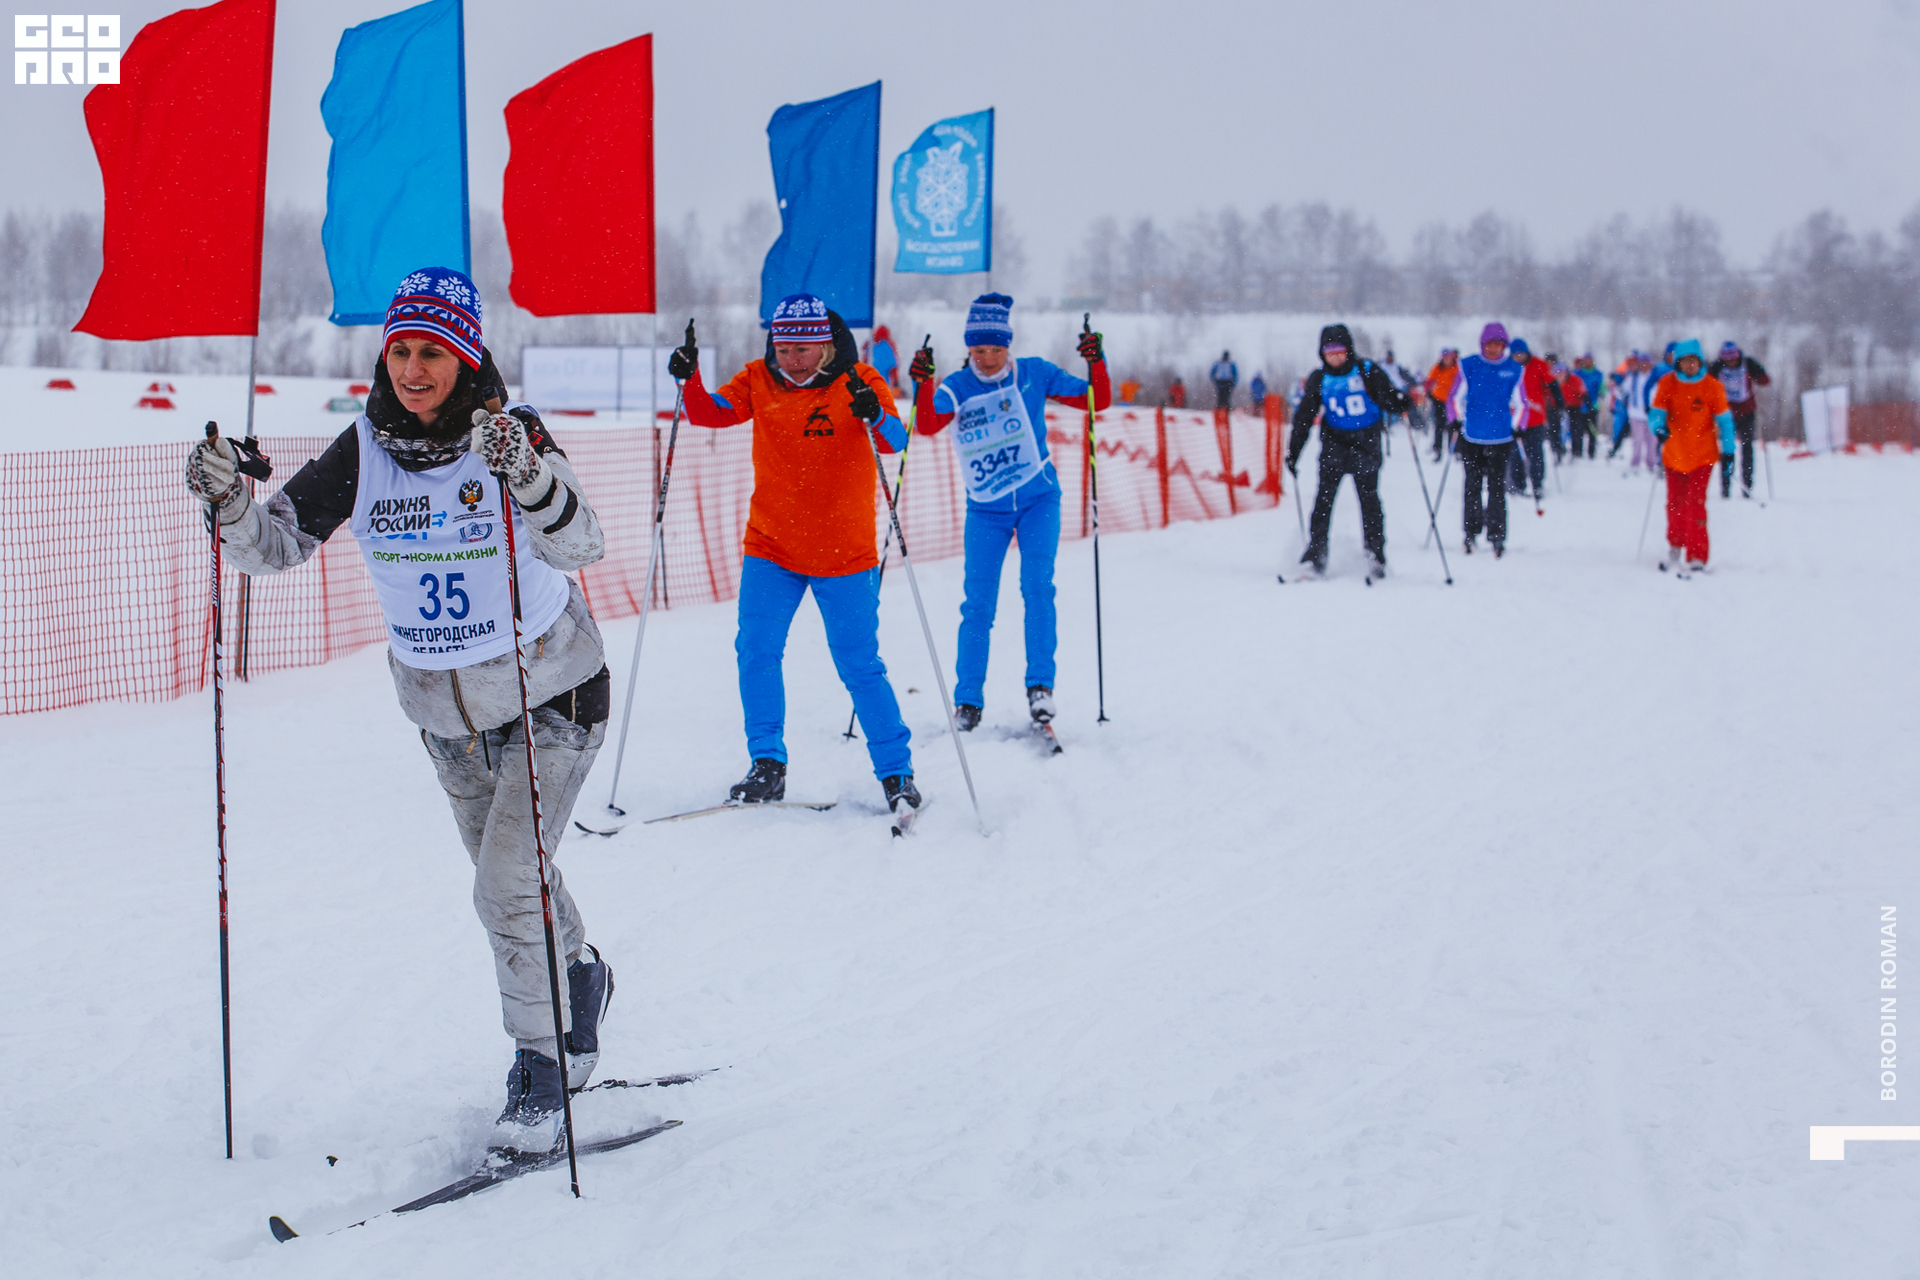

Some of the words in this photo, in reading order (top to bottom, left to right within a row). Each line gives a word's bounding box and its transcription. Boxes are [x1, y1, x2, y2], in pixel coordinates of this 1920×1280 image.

[804, 428, 834, 437] ГАЗ
[970, 444, 1020, 482] 3347
[410, 552, 452, 562] НОРМА
[453, 546, 498, 561] ЖИЗНИ
[418, 572, 470, 621] 35
